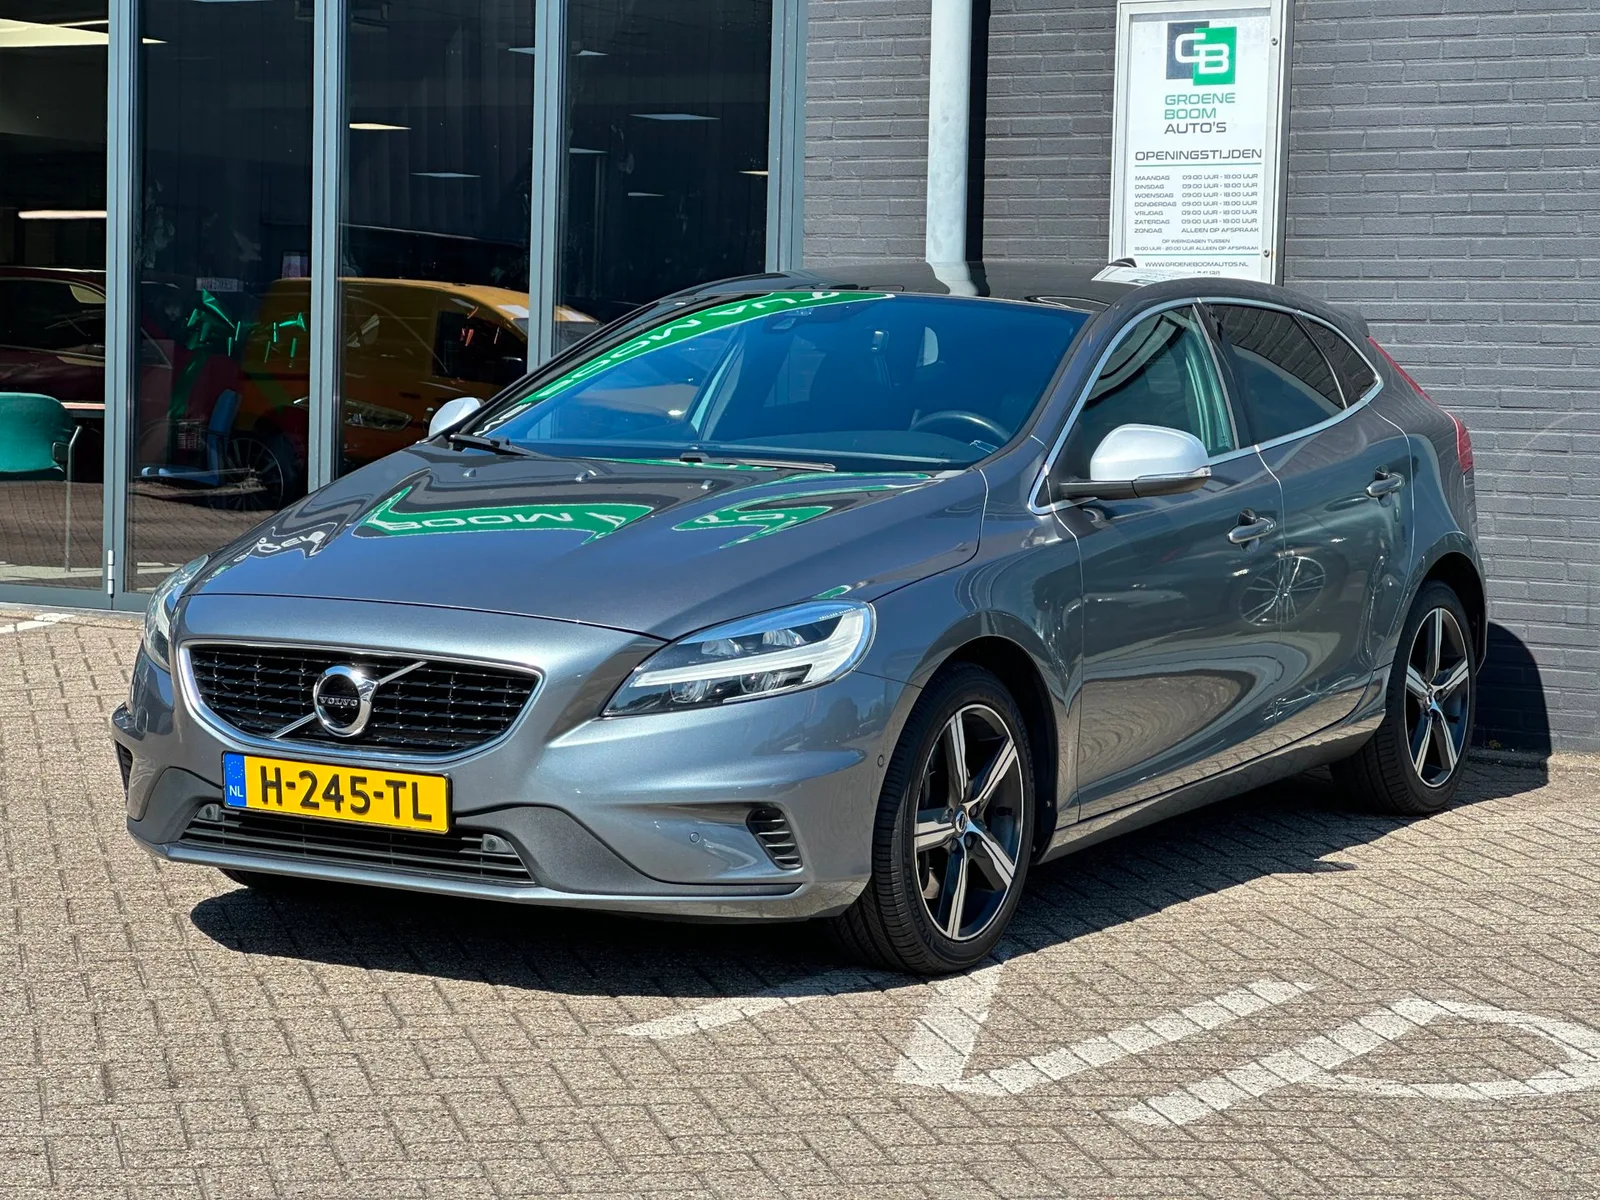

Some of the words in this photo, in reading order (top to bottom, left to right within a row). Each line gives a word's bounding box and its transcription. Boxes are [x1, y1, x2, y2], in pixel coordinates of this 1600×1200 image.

[1165, 92, 1236, 105] GROENE
[1164, 108, 1216, 120] BOOM
[1164, 121, 1227, 134] AUTO'S
[1135, 149, 1262, 161] OPENINGSTIJDEN
[318, 696, 358, 707] VOLVO
[229, 786, 244, 798] NL
[260, 765, 432, 822] H-245-TL
